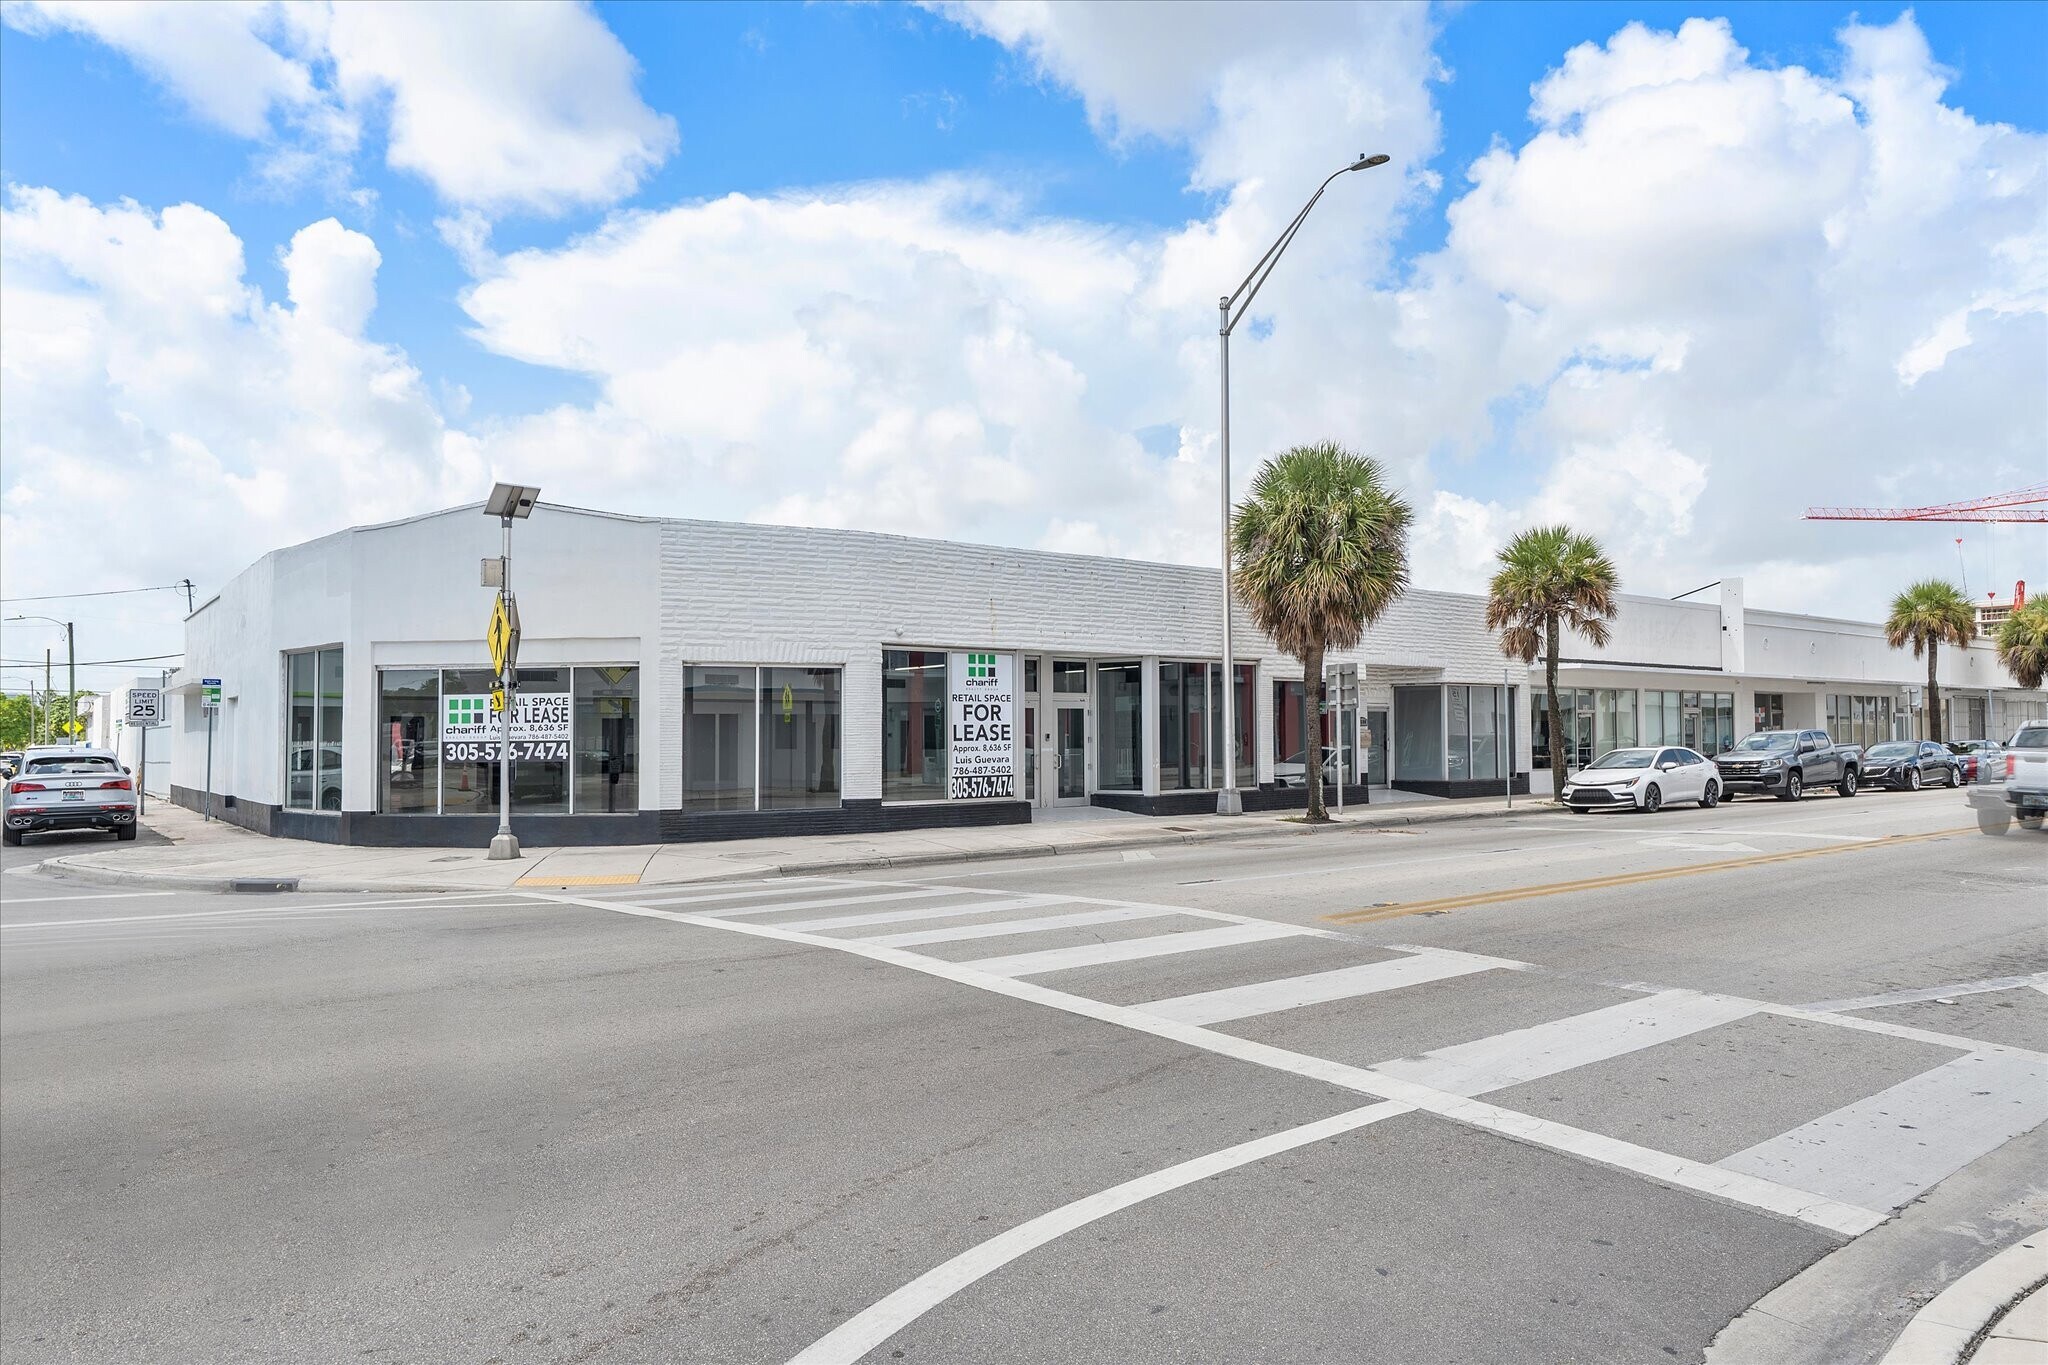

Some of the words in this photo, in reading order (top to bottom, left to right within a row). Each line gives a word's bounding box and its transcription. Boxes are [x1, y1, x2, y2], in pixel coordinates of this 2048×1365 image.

[965, 678, 998, 687] chariff
[532, 697, 569, 706] SPACE
[952, 694, 982, 702] RETAIL
[984, 694, 1011, 702] SPACE
[133, 705, 155, 716] 25
[524, 707, 569, 724] LEASE
[963, 704, 1002, 721] FOR
[446, 725, 487, 734] chariff
[490, 725, 526, 734] Aprox.
[529, 724, 555, 732] 8,636
[953, 724, 1011, 741] LEASE
[446, 742, 568, 761] 305-576-7474
[953, 744, 981, 754] Approx.
[982, 744, 1002, 752] 8,636
[1003, 743, 1012, 751] SF
[955, 756, 972, 764] Luis
[974, 755, 1010, 764] Guevara
[953, 766, 1011, 775] 786-487-5402
[952, 776, 1014, 798] 305-576-7474
